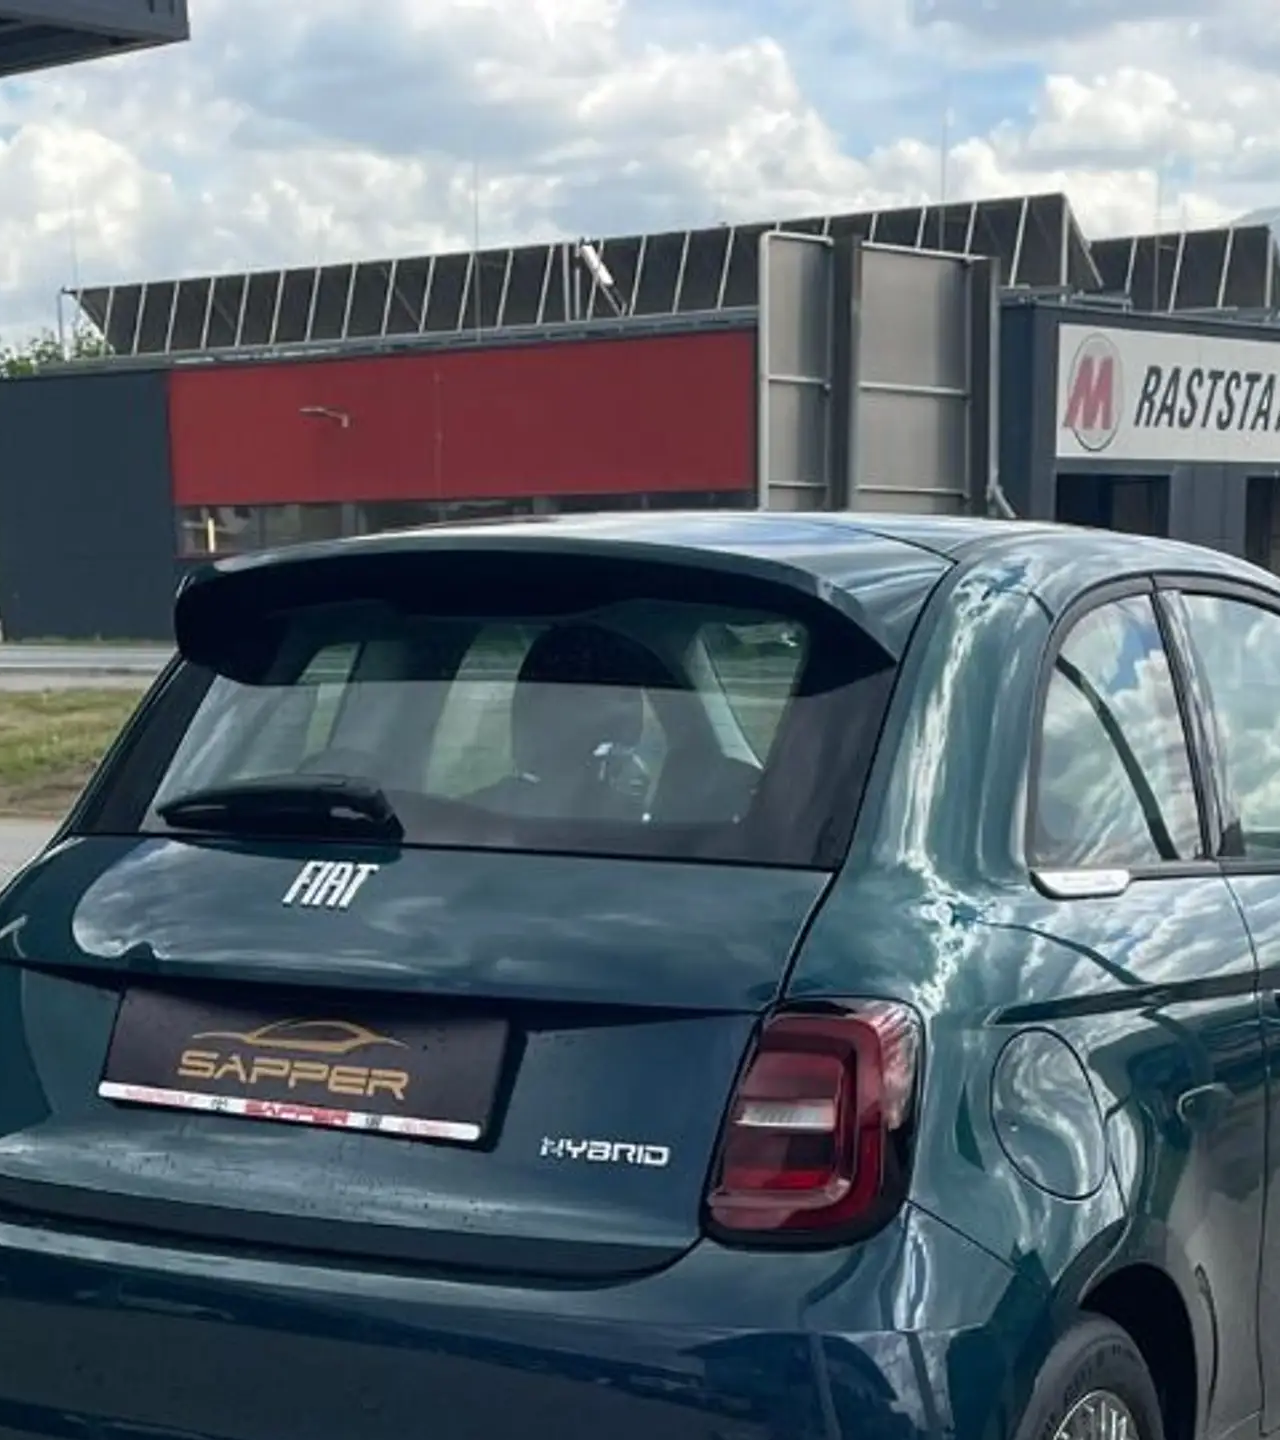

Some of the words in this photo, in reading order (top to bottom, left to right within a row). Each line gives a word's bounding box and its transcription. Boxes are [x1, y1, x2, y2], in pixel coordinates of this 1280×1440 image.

[282, 861, 380, 907] FIAT
[177, 1049, 410, 1100] SAPPER
[539, 1136, 670, 1167] HYBRID
